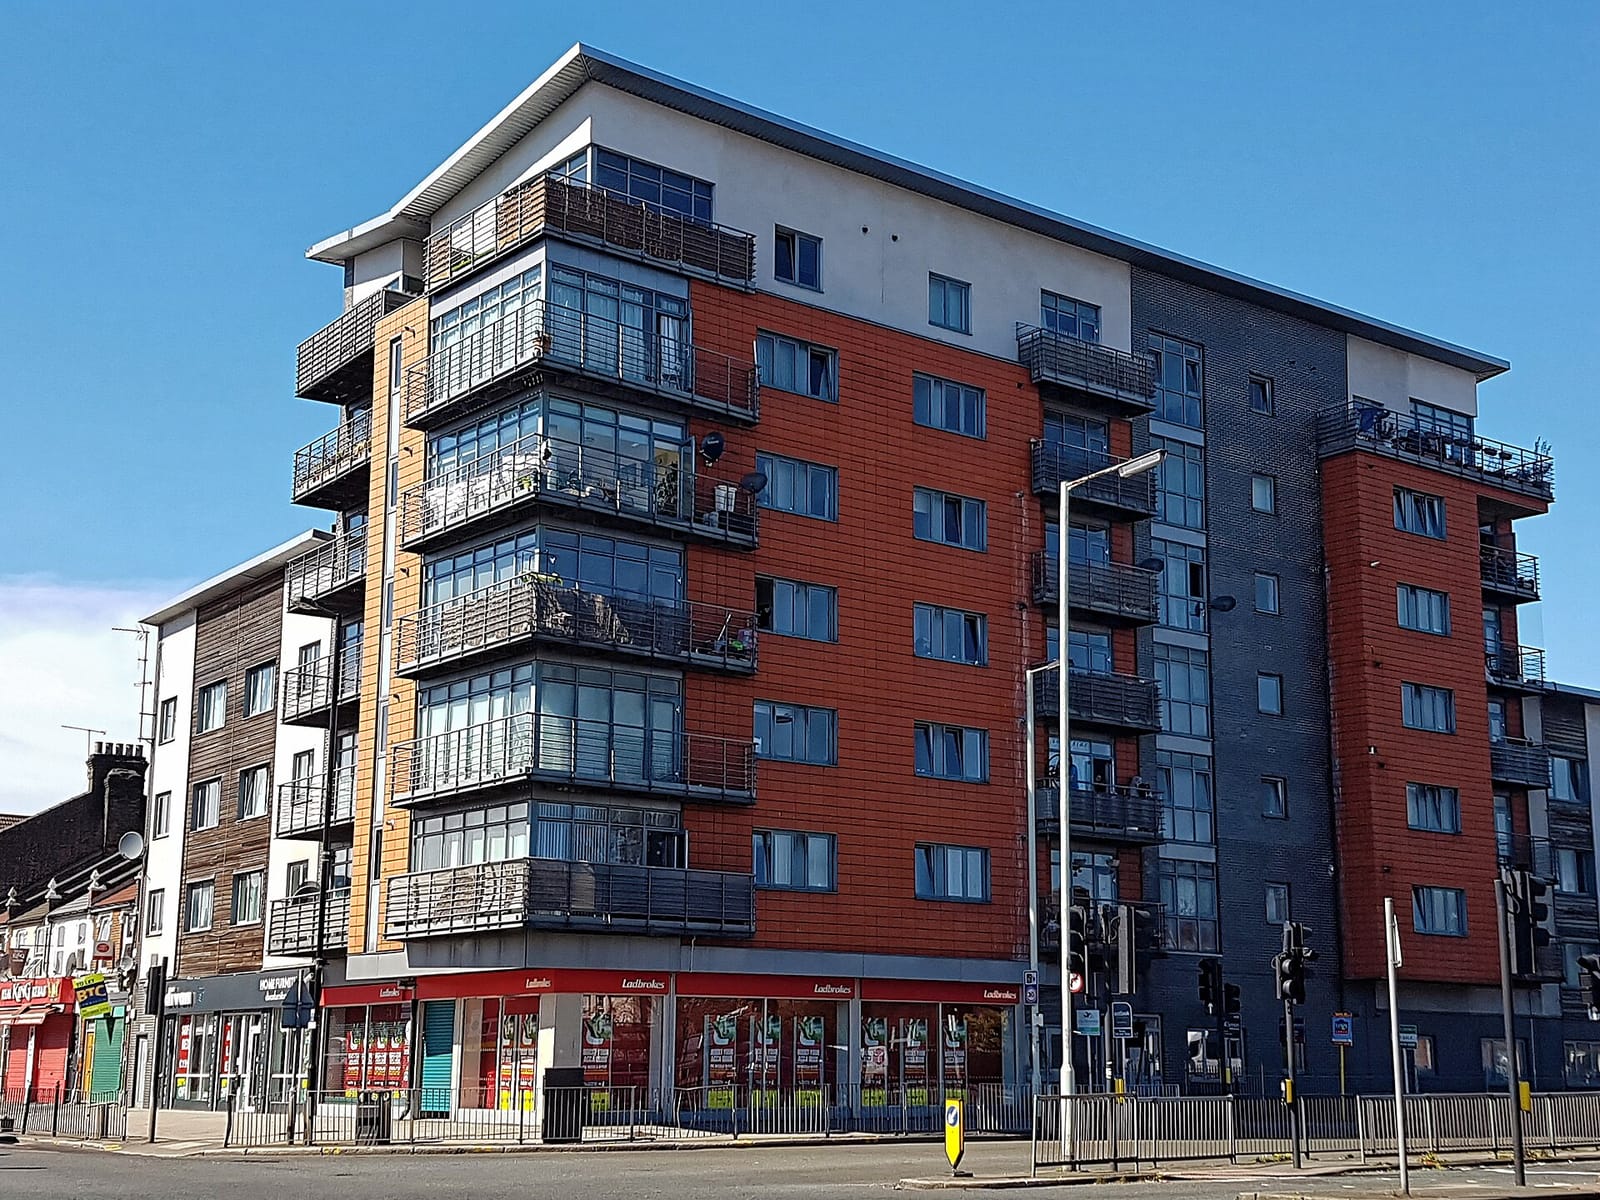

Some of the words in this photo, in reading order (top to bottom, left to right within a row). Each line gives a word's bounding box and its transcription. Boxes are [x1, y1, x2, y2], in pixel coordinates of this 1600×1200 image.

[622, 978, 665, 989] Ladbrokes
[814, 983, 851, 994] Ladbrokes
[76, 985, 107, 1003] BTC
[983, 989, 1017, 1000] Ladbrokes
